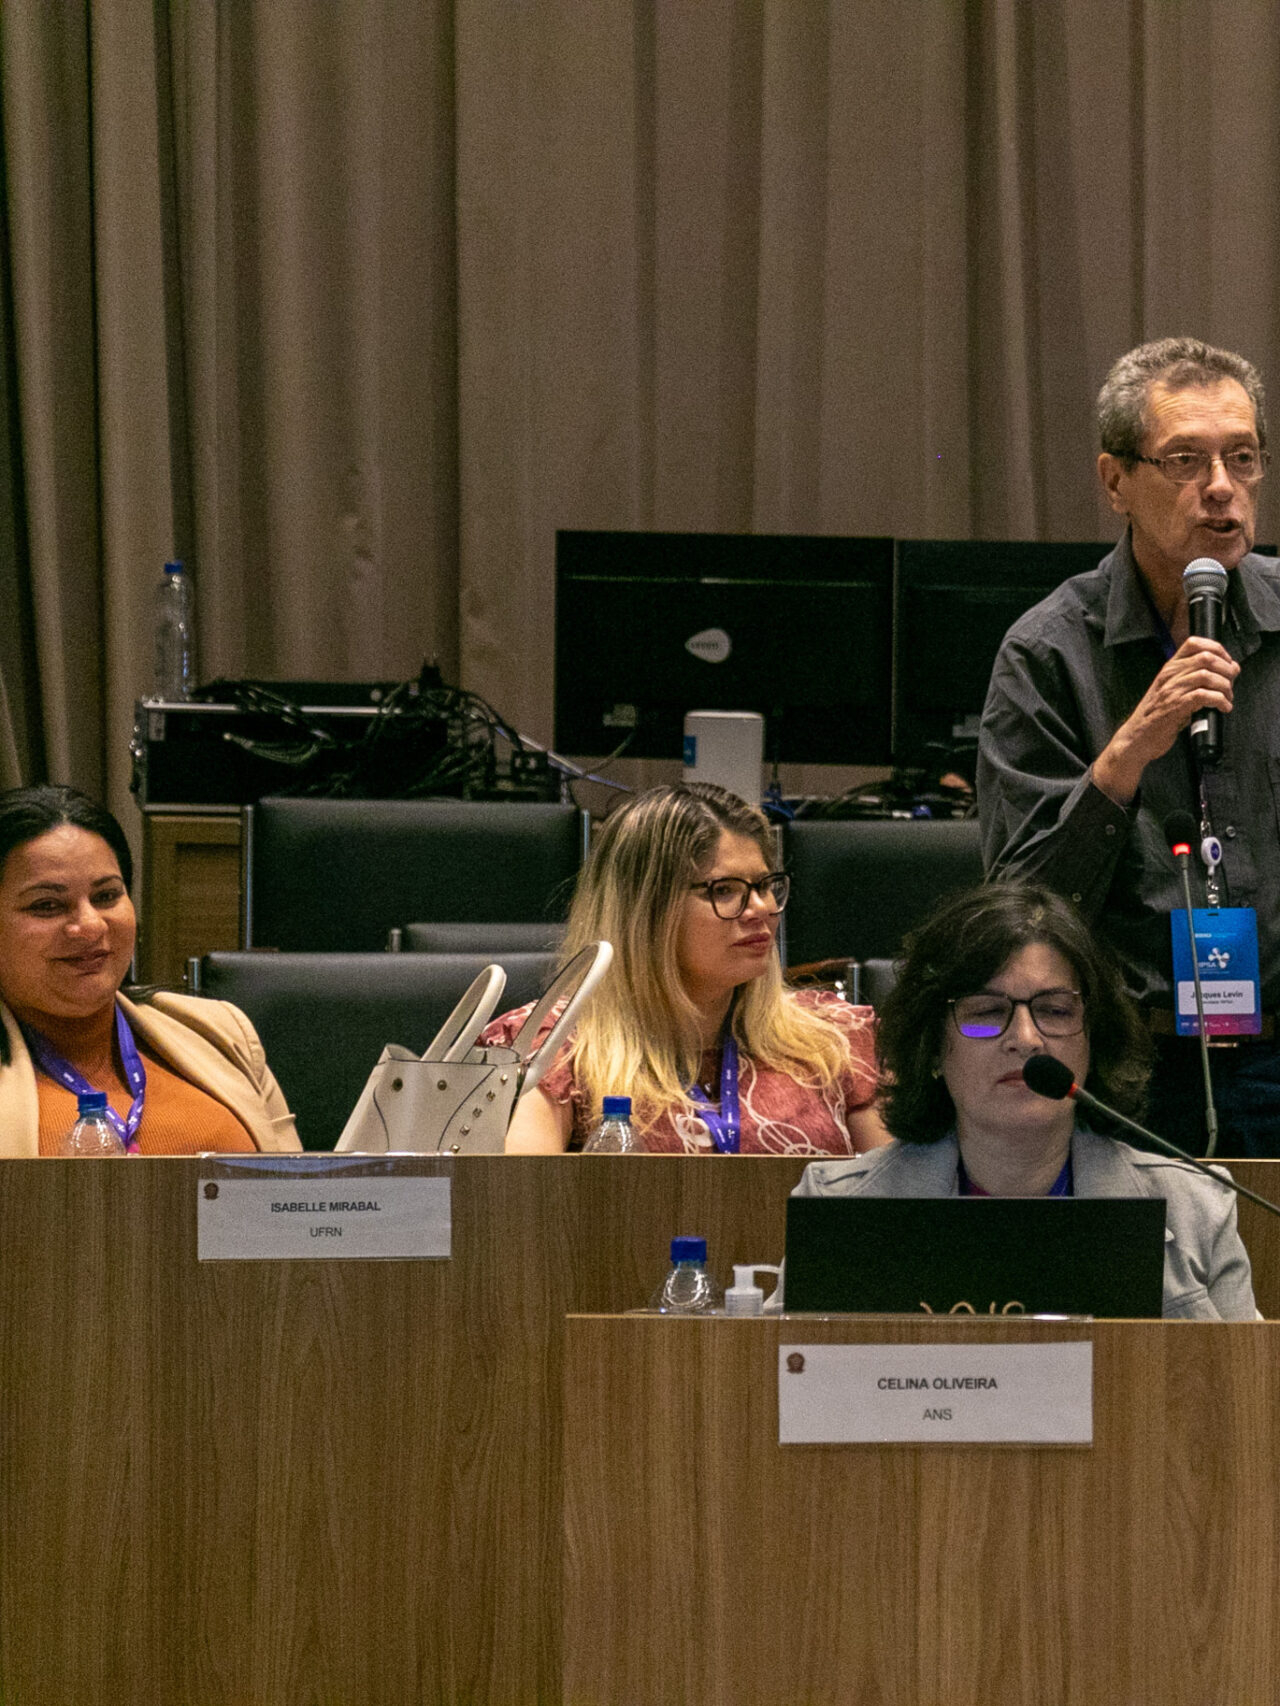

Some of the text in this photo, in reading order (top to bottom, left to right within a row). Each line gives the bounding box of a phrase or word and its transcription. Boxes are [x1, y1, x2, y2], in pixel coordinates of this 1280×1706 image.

[271, 1201, 381, 1213] ISABELLE MIRABAL
[310, 1227, 343, 1238] UFRN
[877, 1378, 998, 1390] CELINA OLIVEIRA
[922, 1408, 953, 1421] ANS
